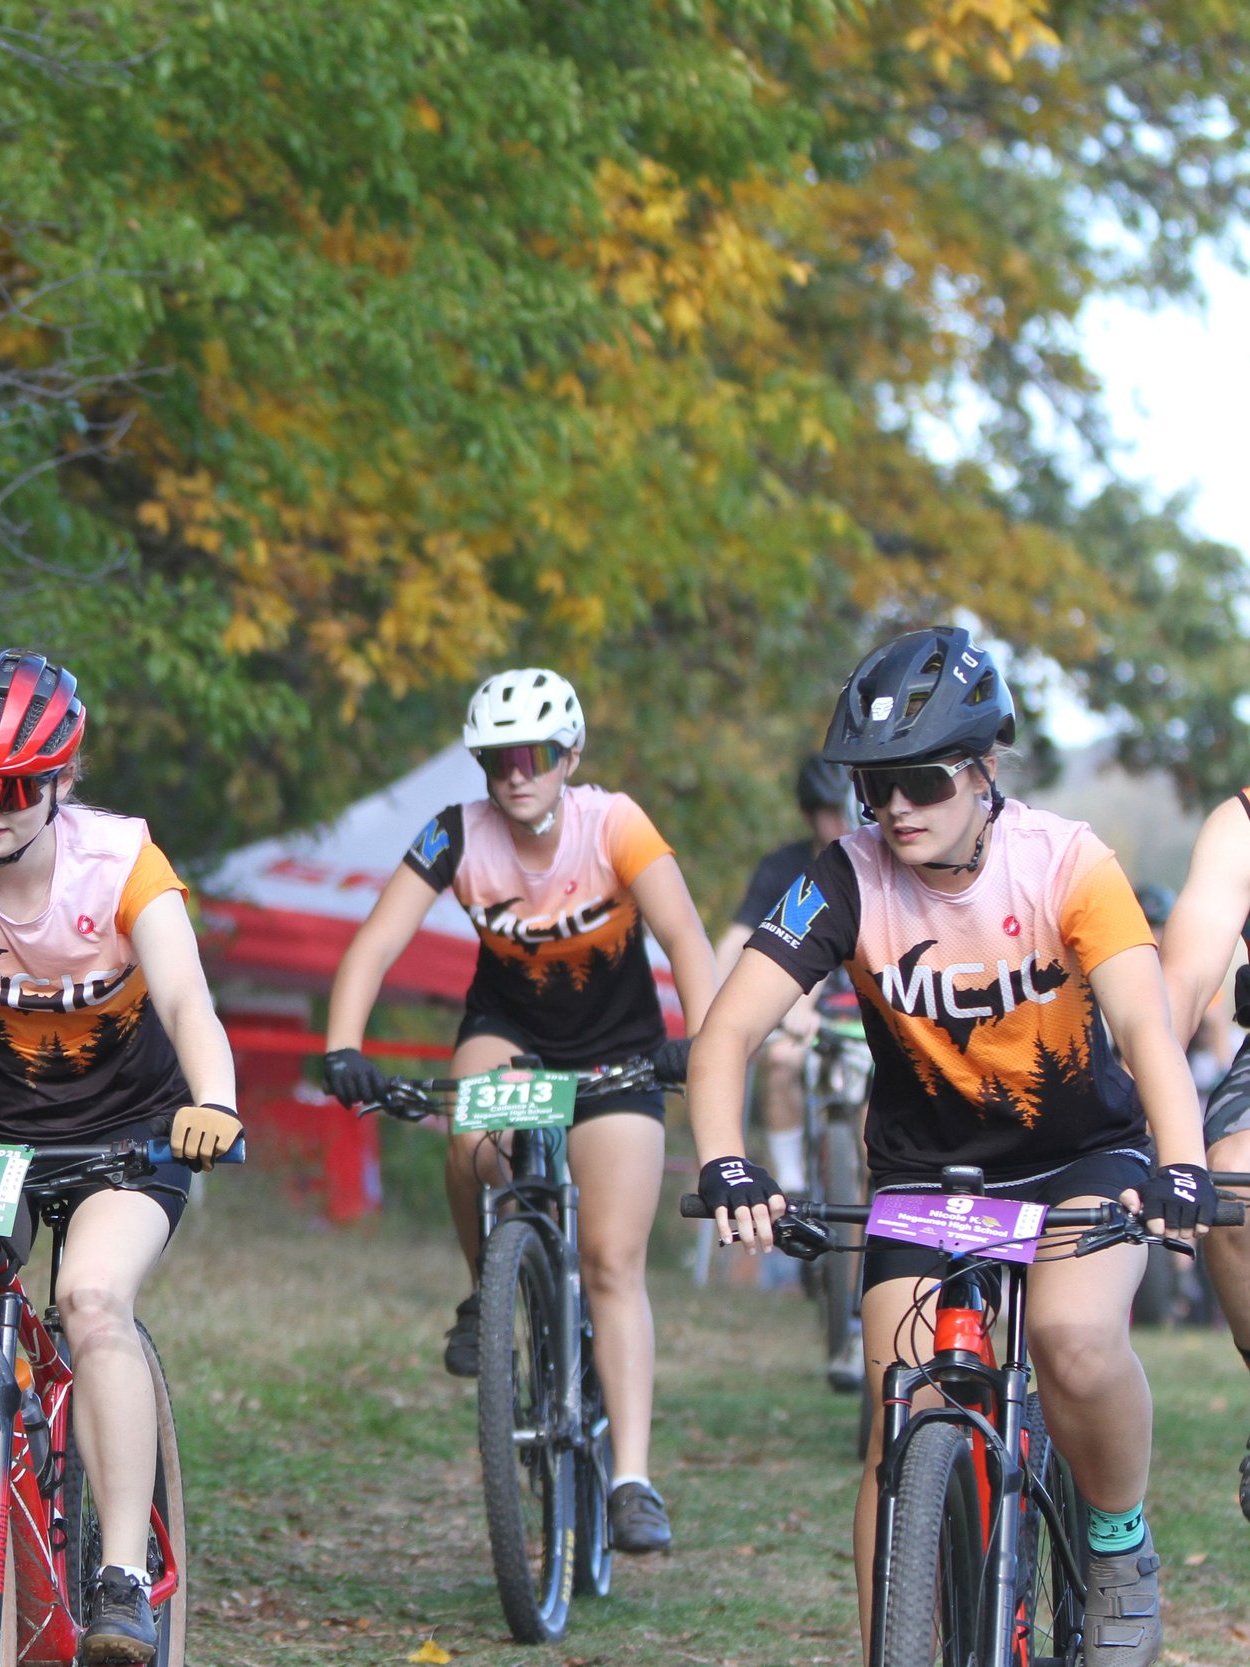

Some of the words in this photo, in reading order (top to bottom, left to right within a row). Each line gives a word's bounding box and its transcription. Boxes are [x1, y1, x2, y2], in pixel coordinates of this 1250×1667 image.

[469, 896, 611, 944] MCIC
[882, 949, 1057, 1020] MCIC
[477, 1082, 552, 1107] 3713
[720, 1161, 754, 1186] FOX
[1169, 1169, 1197, 1203] FOX
[929, 1209, 967, 1222] Nicole
[945, 1197, 975, 1215] 9
[898, 1212, 948, 1227] Negaunee
[948, 1220, 972, 1232] High
[974, 1225, 1009, 1238] School
